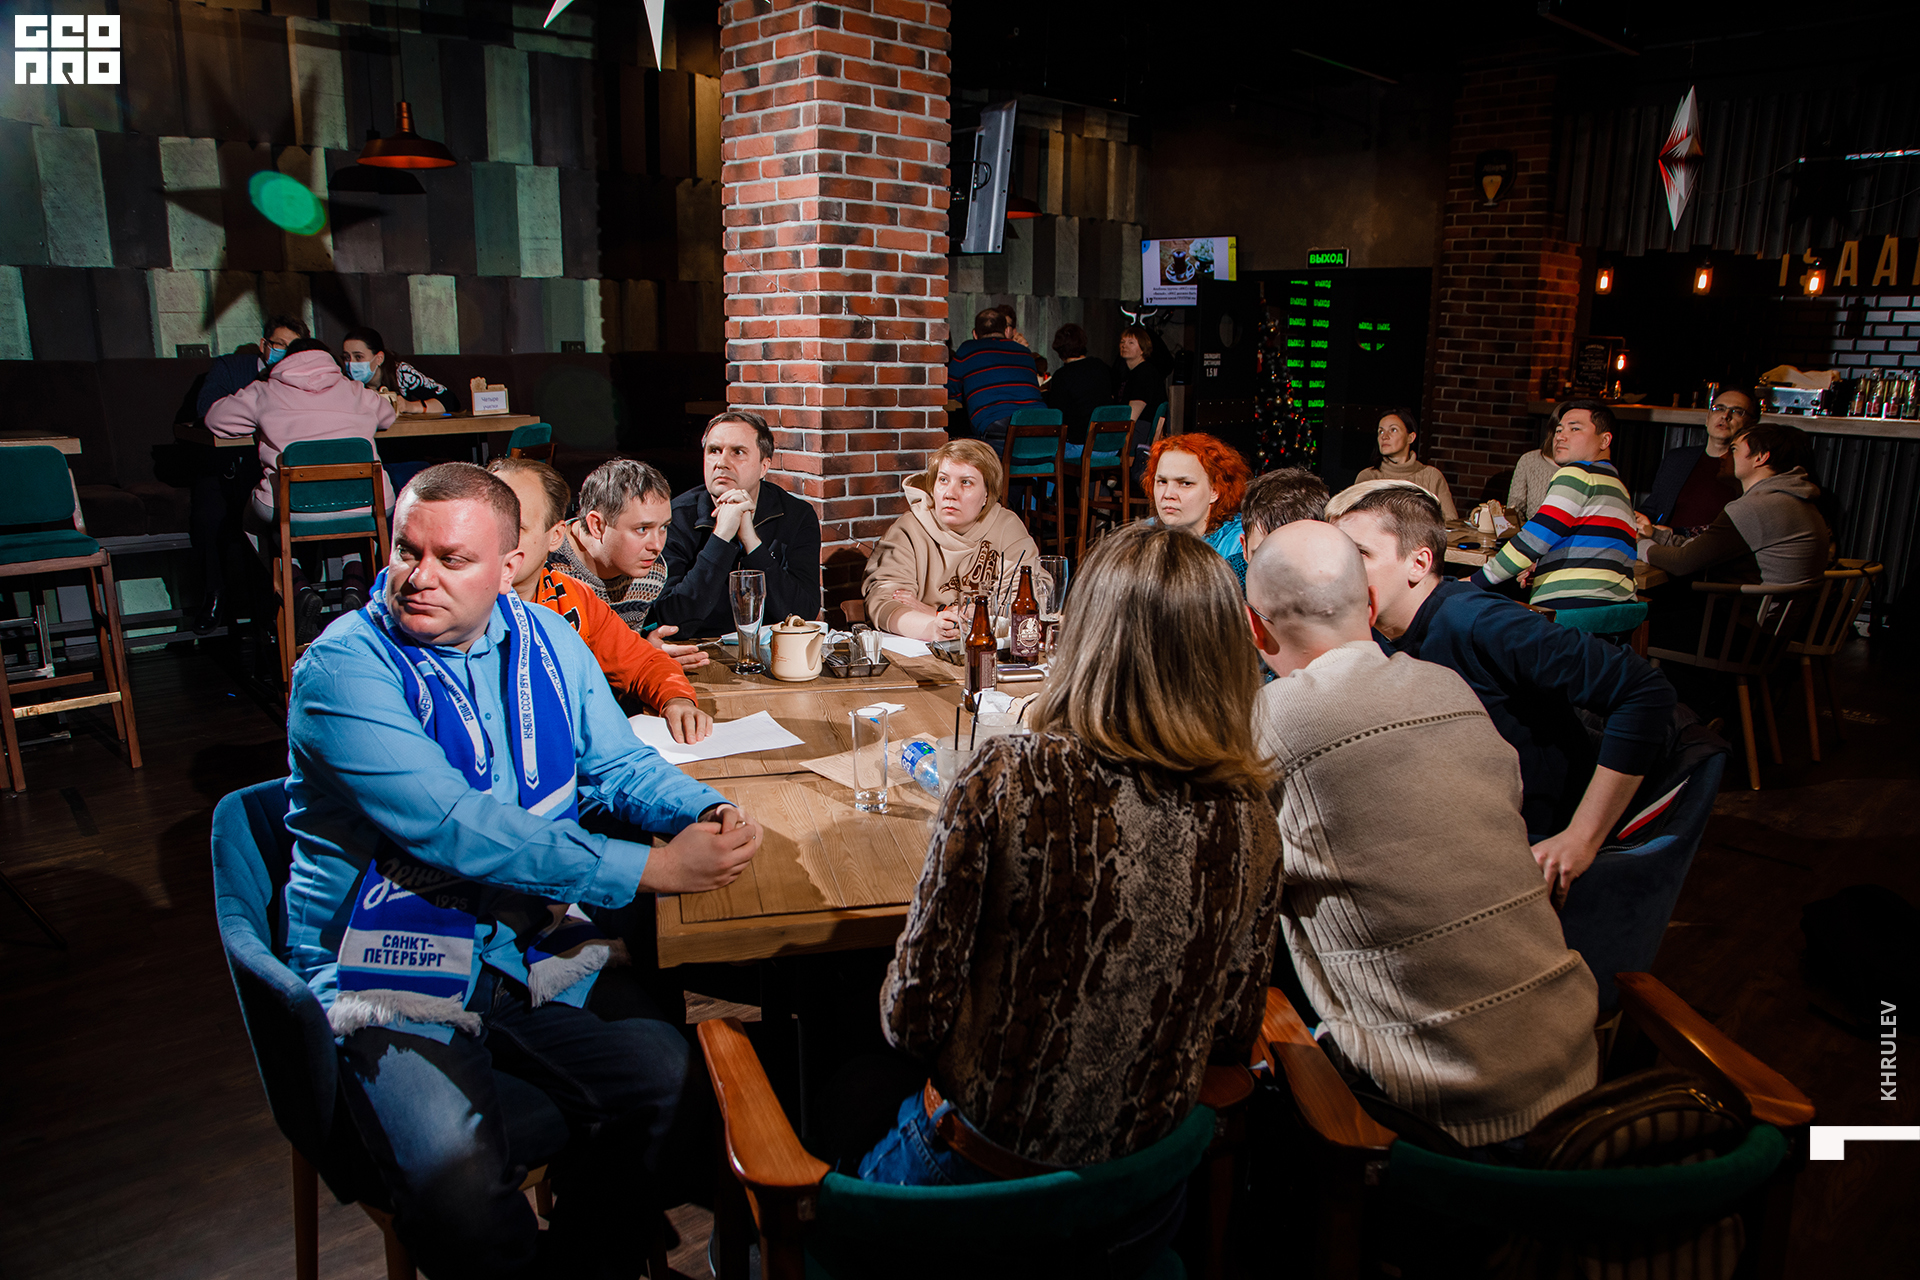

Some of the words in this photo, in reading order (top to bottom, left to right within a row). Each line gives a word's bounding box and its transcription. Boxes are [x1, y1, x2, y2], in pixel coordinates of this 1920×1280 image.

[1309, 252, 1344, 264] ВЫХОД
[516, 612, 528, 633] СССР
[520, 633, 529, 669] ЧЕМПИОН
[520, 690, 531, 711] СССР
[434, 894, 469, 910] 1925
[382, 934, 435, 951] САНКТ-
[362, 948, 446, 967] ПЕТЕРБУРГ
